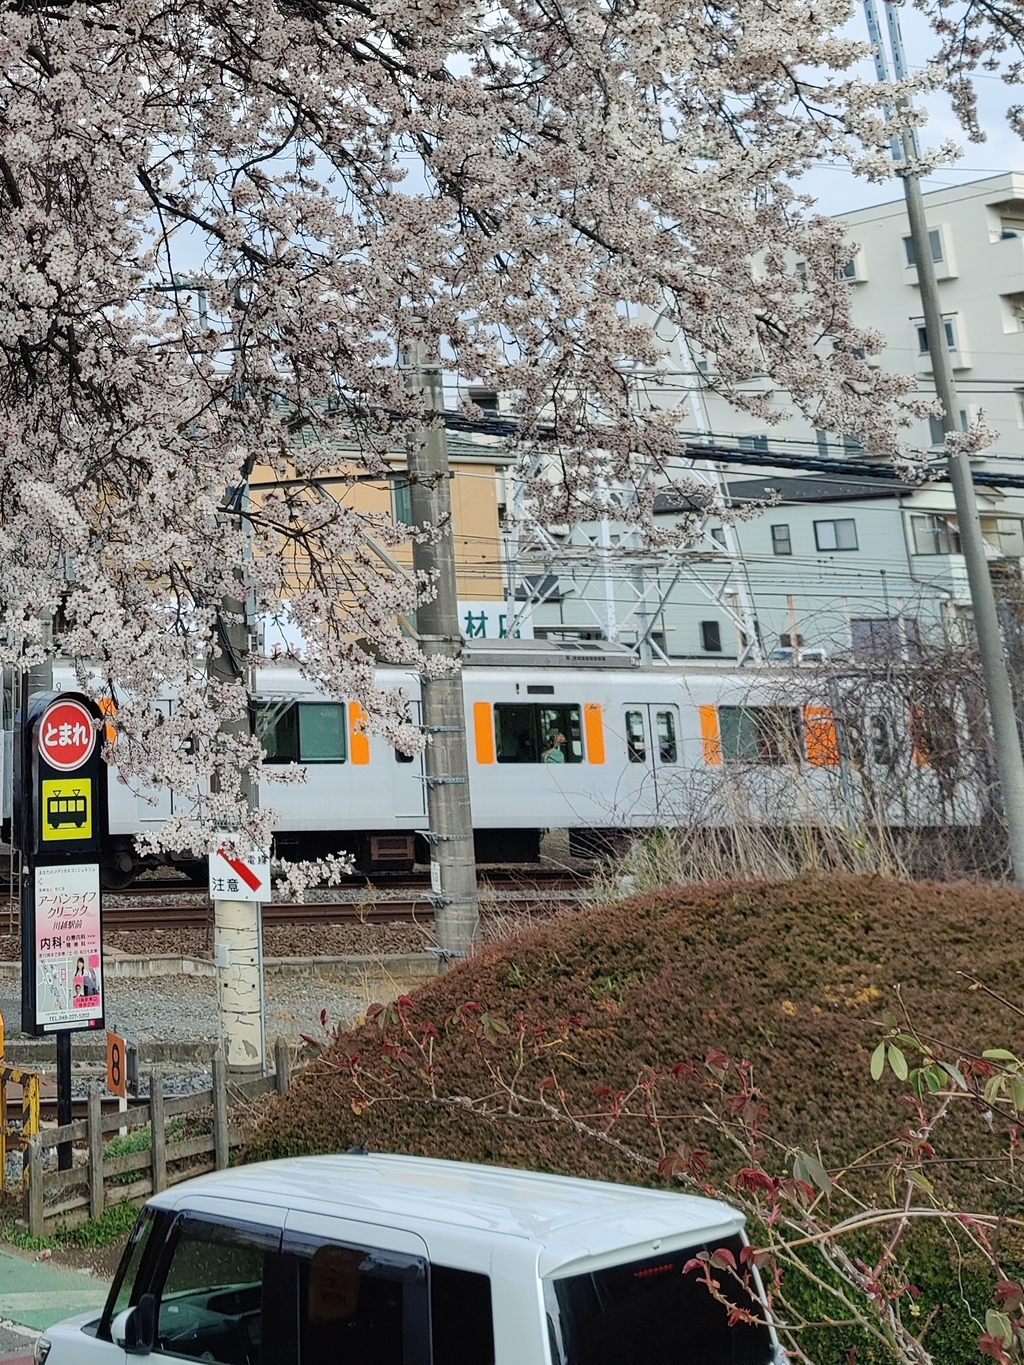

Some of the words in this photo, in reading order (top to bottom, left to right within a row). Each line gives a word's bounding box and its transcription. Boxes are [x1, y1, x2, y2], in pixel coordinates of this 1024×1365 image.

[44, 722, 88, 746] とまれ
[212, 877, 239, 892] 注意
[38, 891, 96, 906] アーバンライフ
[47, 905, 88, 919] クリニック
[52, 919, 83, 931] 川越駅前
[111, 1043, 120, 1086] 8
